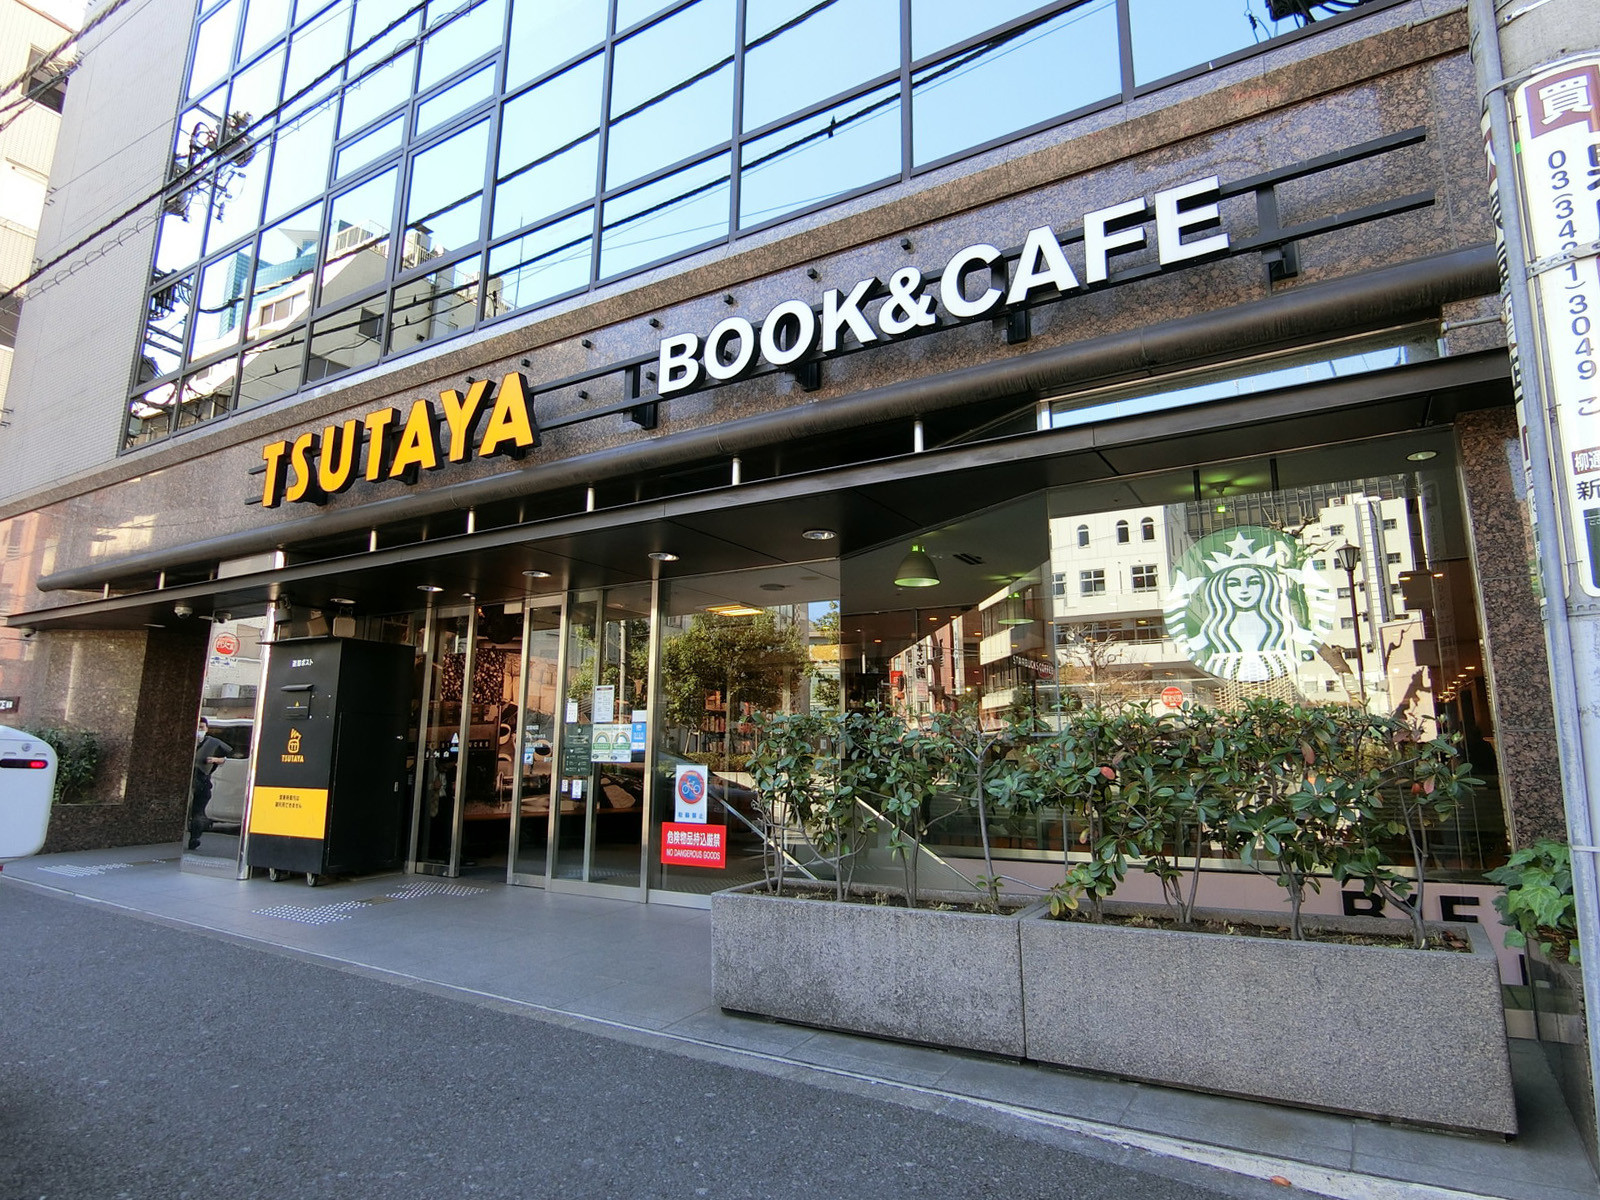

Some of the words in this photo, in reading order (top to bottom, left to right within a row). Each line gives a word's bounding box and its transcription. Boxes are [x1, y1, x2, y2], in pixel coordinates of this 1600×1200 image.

[1538, 75, 1593, 125] 買
[658, 175, 1230, 395] BOOK&CAFE
[261, 371, 535, 508] TSUTAYA
[281, 754, 304, 763] TSUTAYA
[666, 848, 674, 857] NO
[674, 849, 702, 859] DANGEROUS
[703, 851, 721, 860] GOODS
[667, 830, 720, 847] 危険物品持込厳禁
